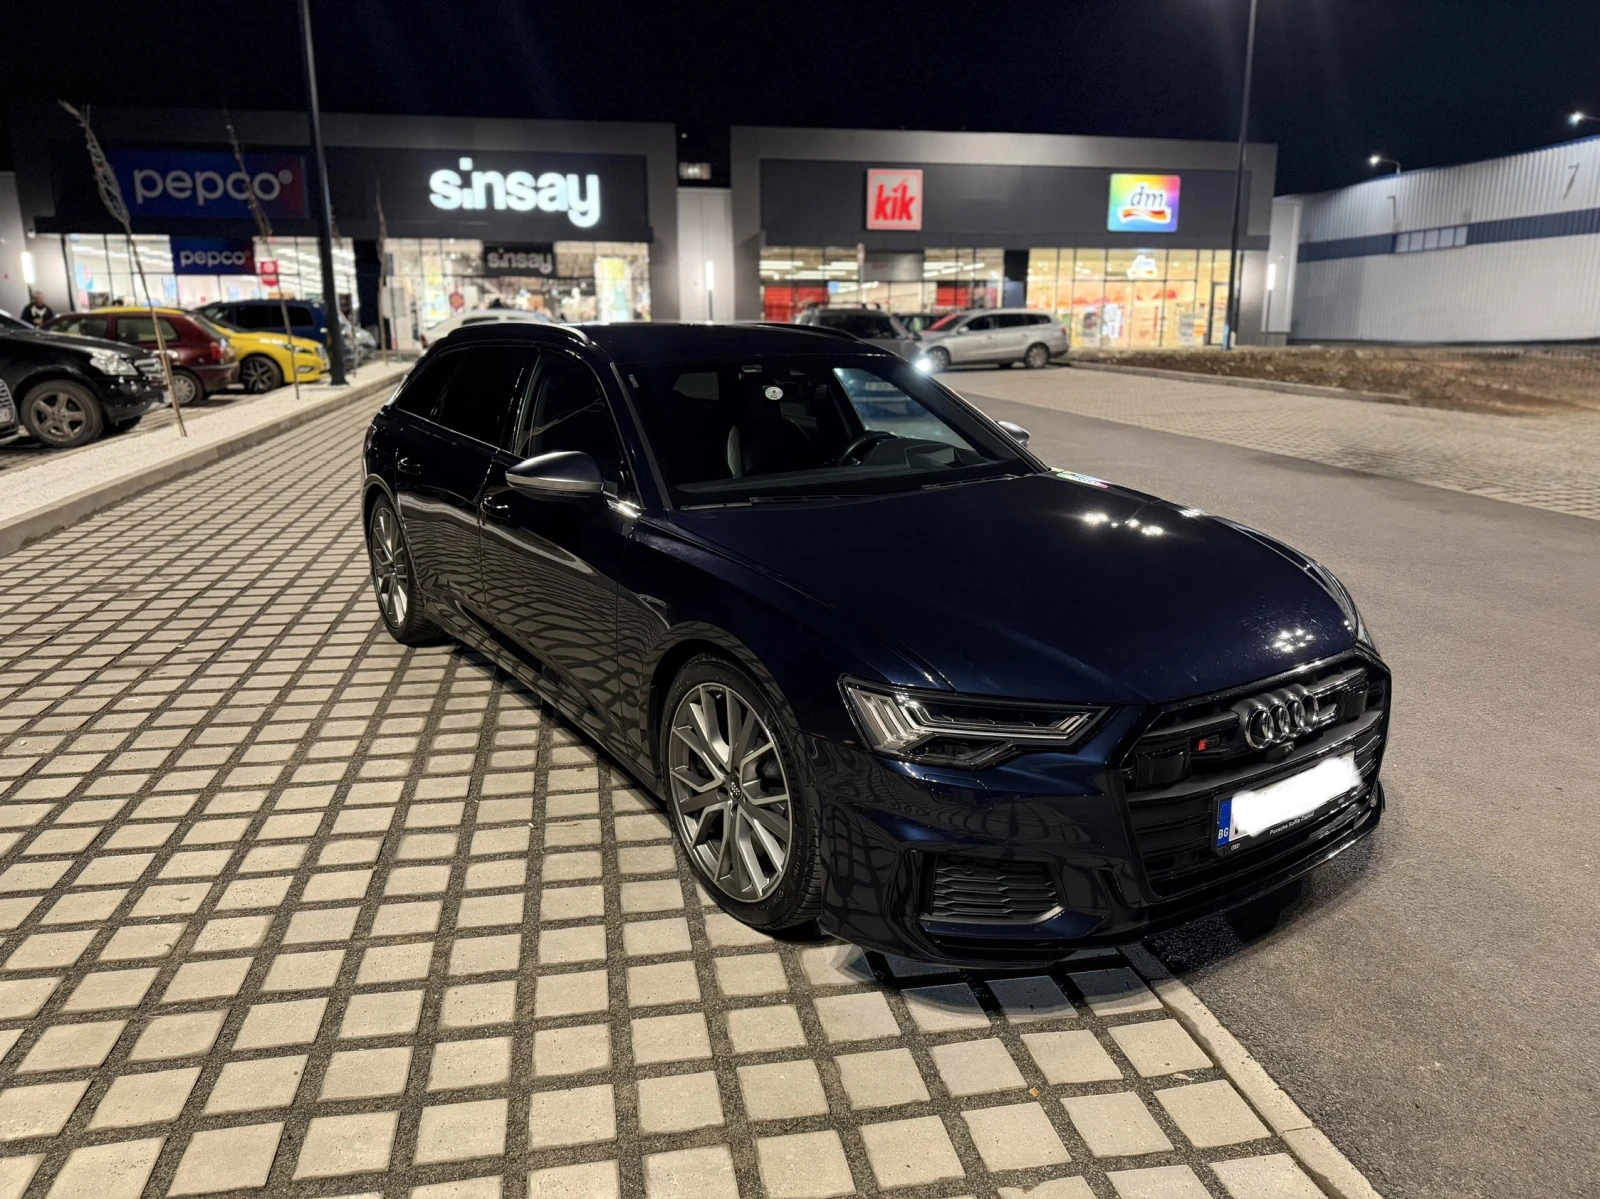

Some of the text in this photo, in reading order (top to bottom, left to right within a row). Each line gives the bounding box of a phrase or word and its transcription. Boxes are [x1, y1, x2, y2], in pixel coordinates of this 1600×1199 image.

[133, 169, 281, 206] pepco
[429, 157, 600, 227] sinsay
[874, 179, 915, 221] kik
[1130, 184, 1165, 207] dm
[180, 250, 246, 268] pepco
[487, 247, 553, 274] sinsay
[1218, 827, 1229, 839] BG
[1269, 824, 1288, 835] Porsche
